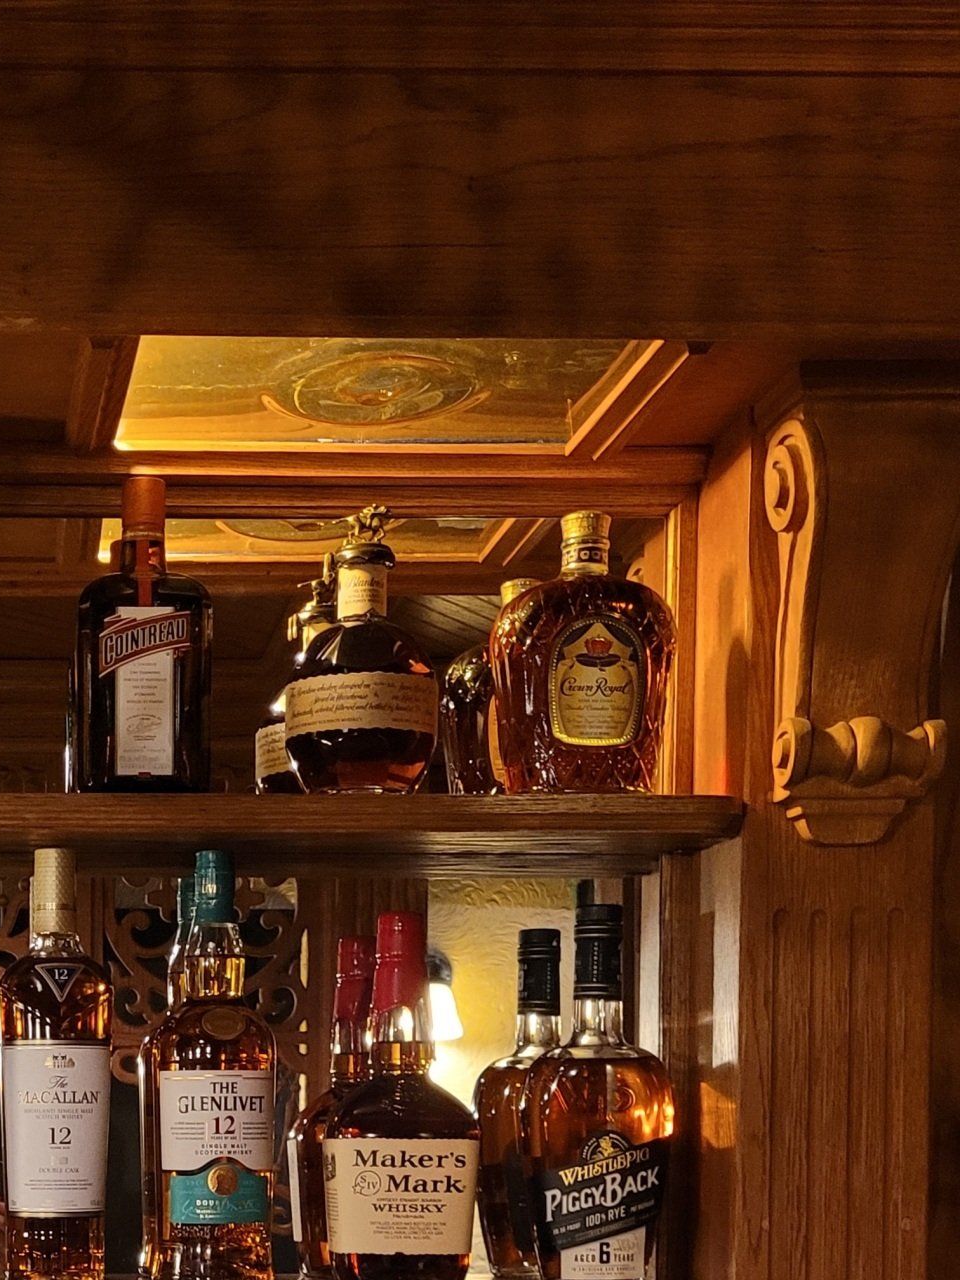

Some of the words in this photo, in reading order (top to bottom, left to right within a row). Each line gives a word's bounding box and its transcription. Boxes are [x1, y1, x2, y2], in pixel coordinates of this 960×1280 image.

[102, 618, 187, 667] COINTREAU
[560, 677, 593, 696] Crown
[592, 677, 630, 696] Royal
[54, 968, 68, 981] 12
[48, 1075, 68, 1089] The
[210, 1082, 238, 1094] THE
[19, 1091, 99, 1104] MACALLAN
[178, 1095, 265, 1114] GLENLIVET
[212, 1115, 236, 1135] 12
[48, 1127, 72, 1145] 12
[352, 1149, 467, 1168] Maker's
[558, 1147, 650, 1187] WHISTLEPIG
[384, 1174, 465, 1194] Mark
[544, 1165, 660, 1222] PIGGYBACK
[371, 1203, 447, 1213] WHISKY
[608, 1205, 627, 1221] RYE
[574, 1253, 596, 1262] AGED
[599, 1242, 611, 1264] 6
[614, 1253, 635, 1262] YEARS
